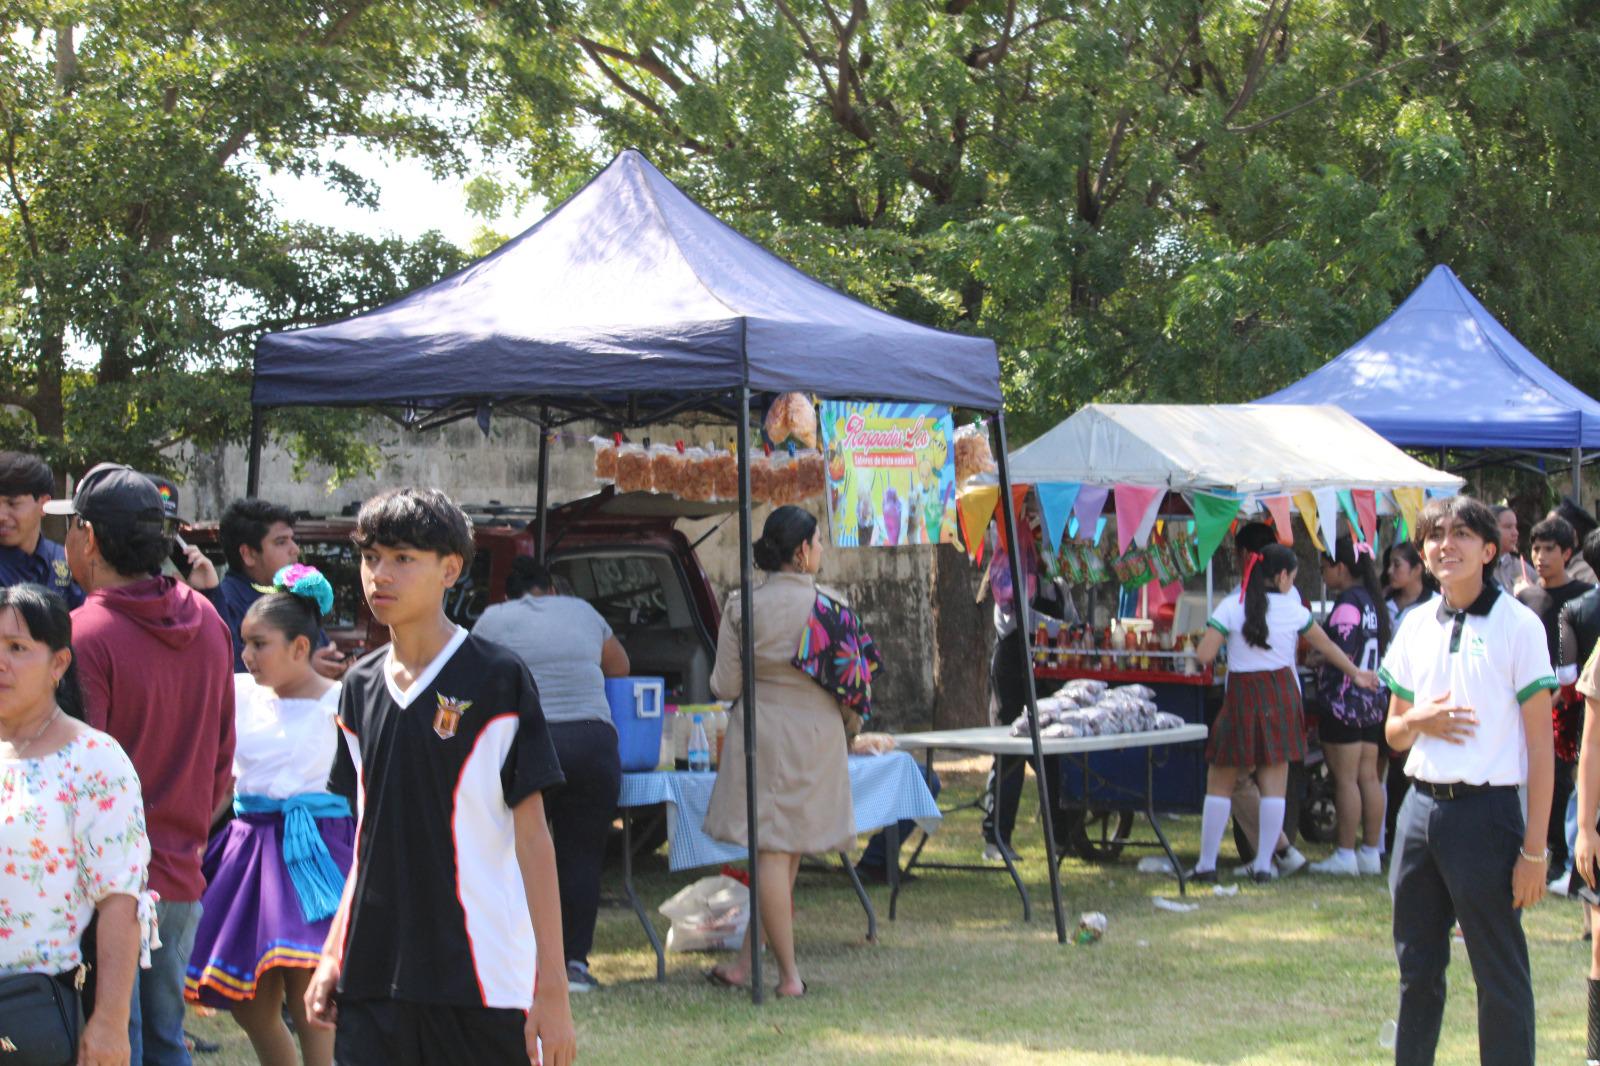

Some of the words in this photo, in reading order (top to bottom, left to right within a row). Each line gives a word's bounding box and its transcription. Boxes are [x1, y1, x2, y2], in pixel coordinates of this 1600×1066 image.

[843, 414, 903, 455] Raspados
[873, 455, 881, 465] de
[894, 455, 914, 465] natural
[1362, 612, 1378, 630] ME
